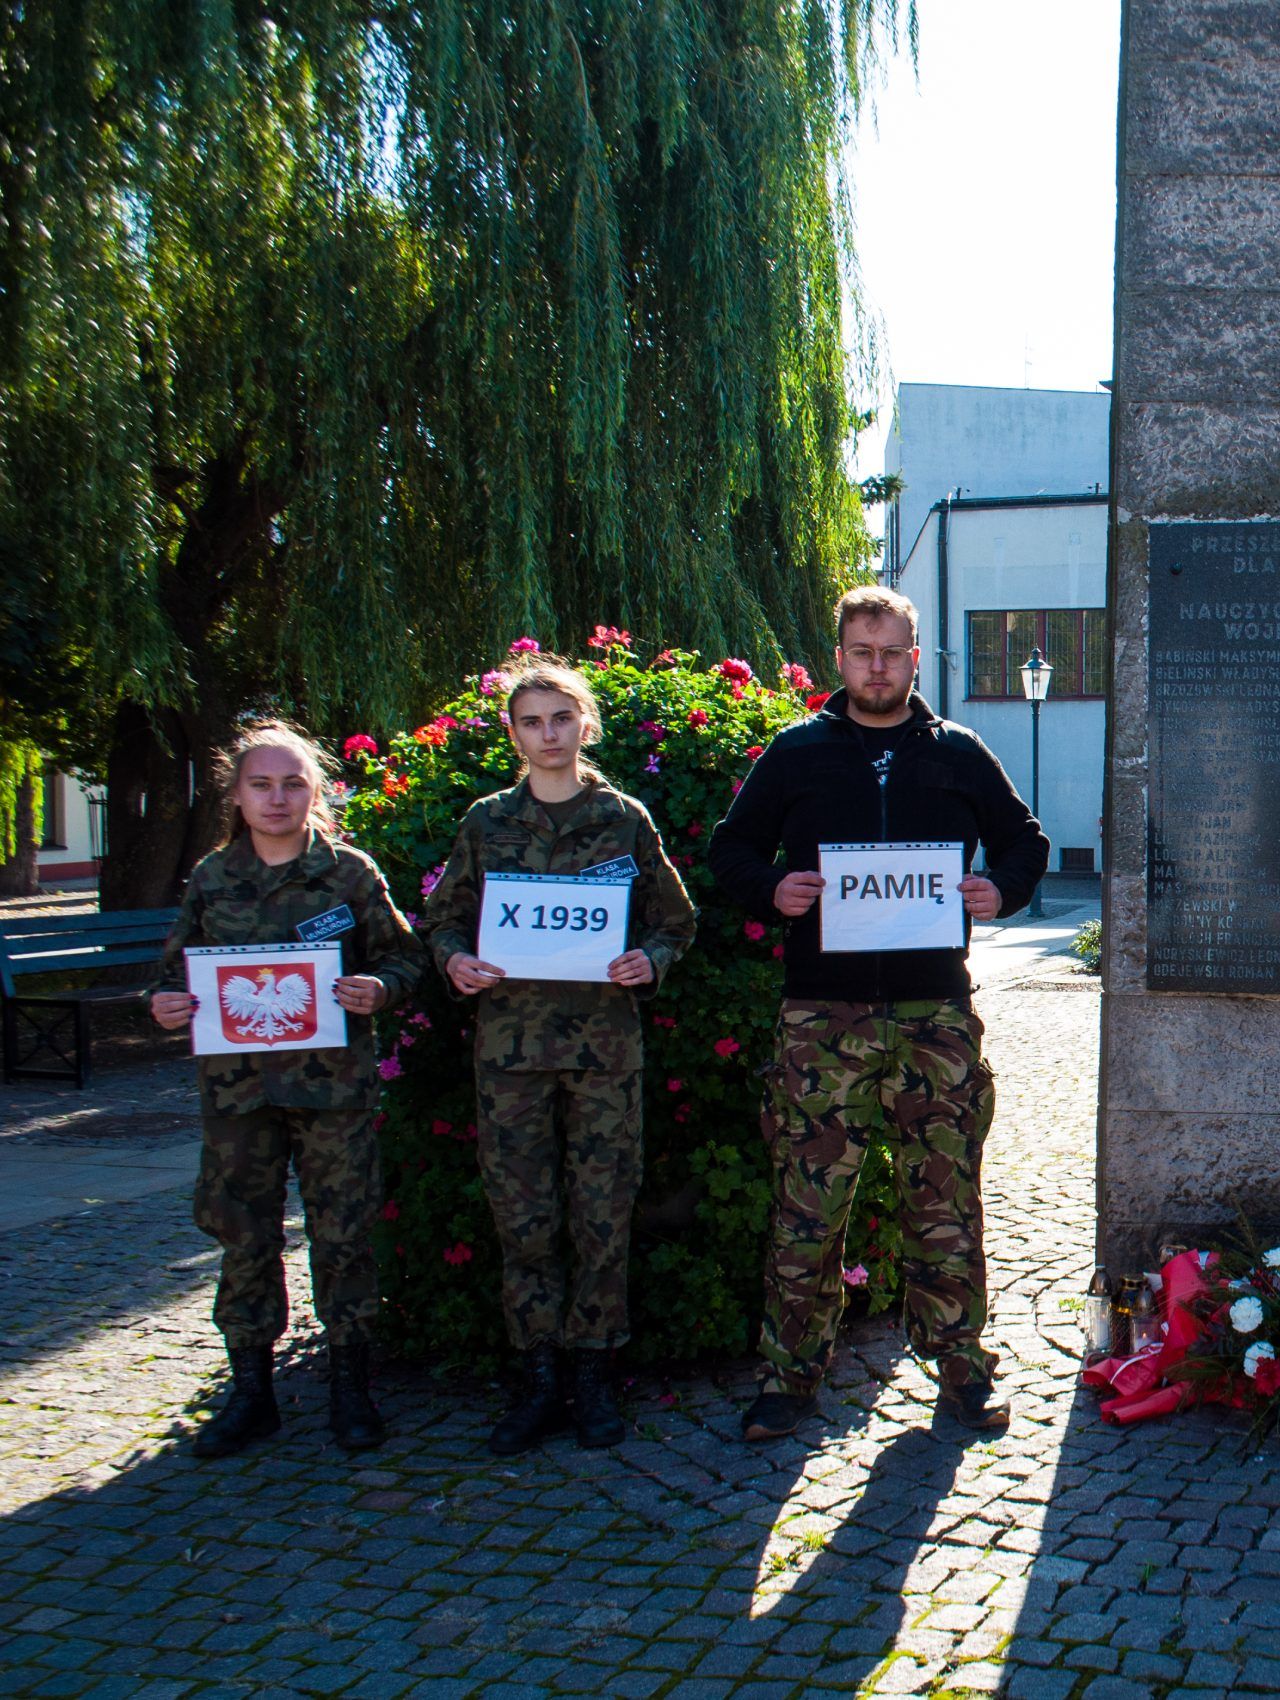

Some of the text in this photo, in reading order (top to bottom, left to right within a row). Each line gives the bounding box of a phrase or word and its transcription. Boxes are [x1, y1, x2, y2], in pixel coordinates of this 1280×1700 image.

[1233, 556, 1276, 573] DLA
[596, 863, 619, 876] KLASA
[840, 873, 945, 905] PAMIĘ
[313, 914, 338, 928] KLASA
[498, 902, 609, 933] X 1939
[1153, 963, 1275, 979] ODEJEWSKI ROMAN
